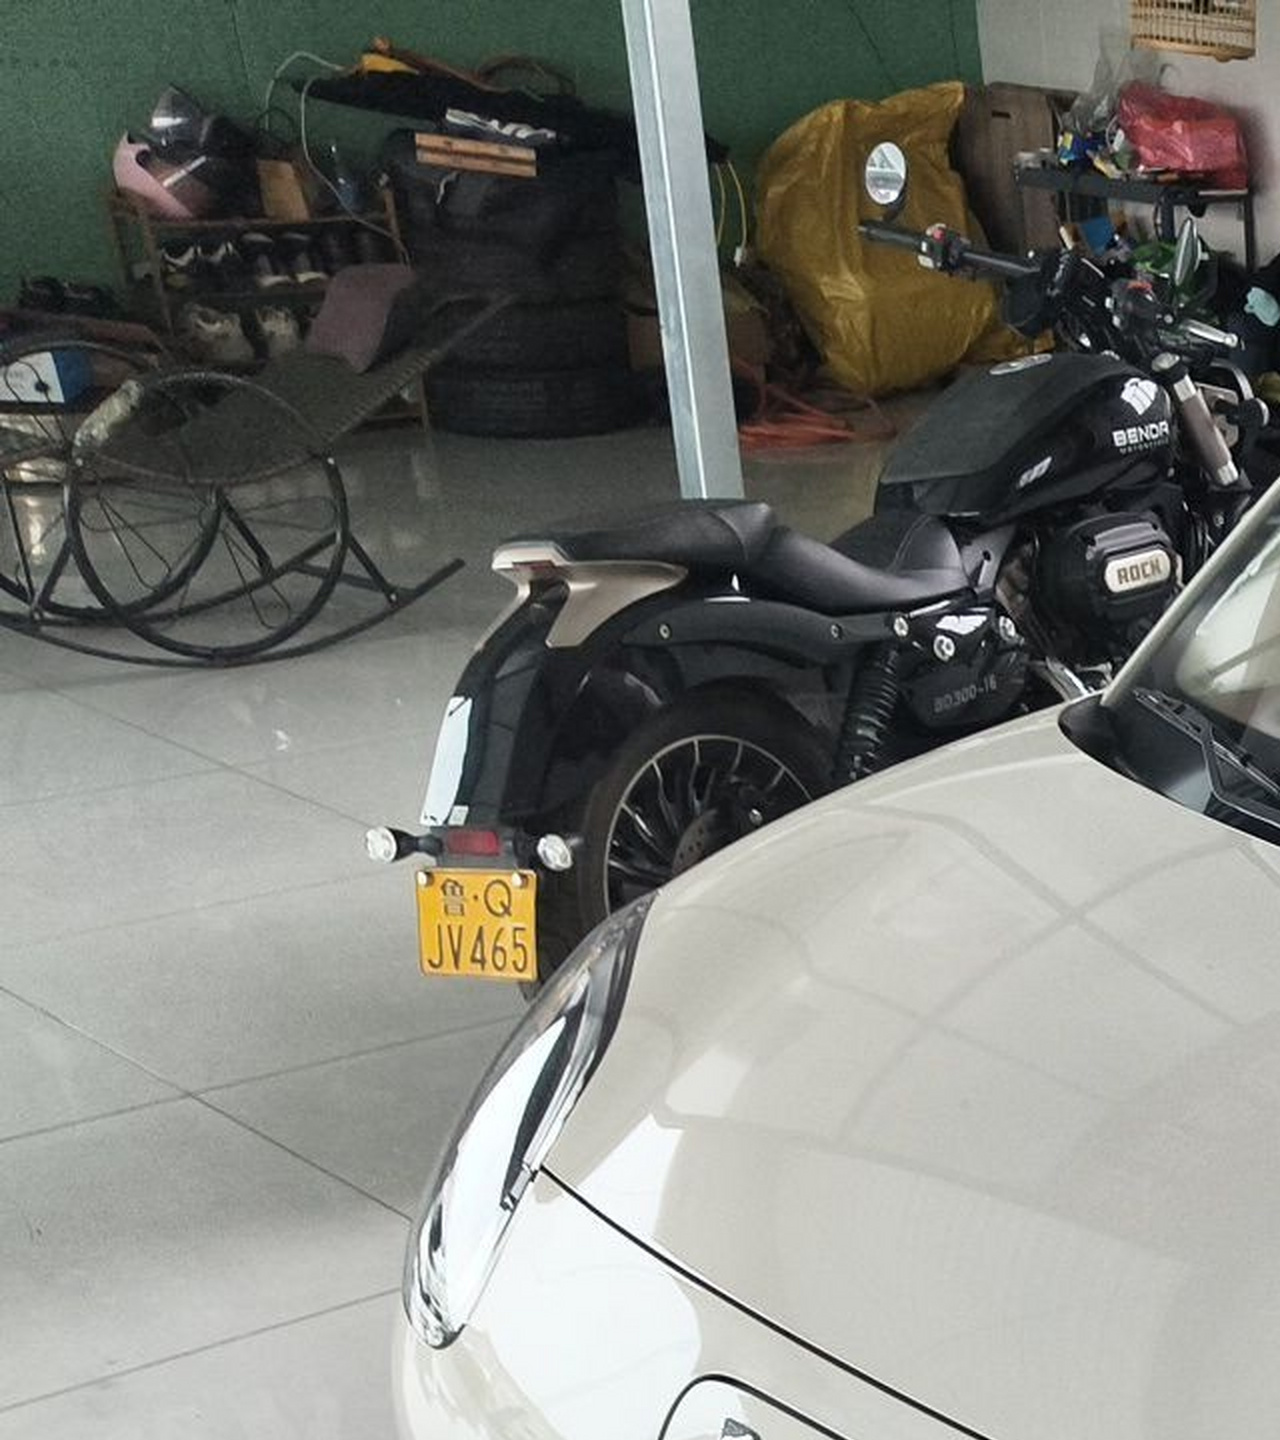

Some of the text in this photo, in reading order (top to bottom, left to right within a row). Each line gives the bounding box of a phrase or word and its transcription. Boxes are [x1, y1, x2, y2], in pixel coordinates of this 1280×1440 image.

[1112, 420, 1170, 447] BENDA
[1117, 557, 1162, 585] ROCK
[427, 924, 528, 973] JV465
